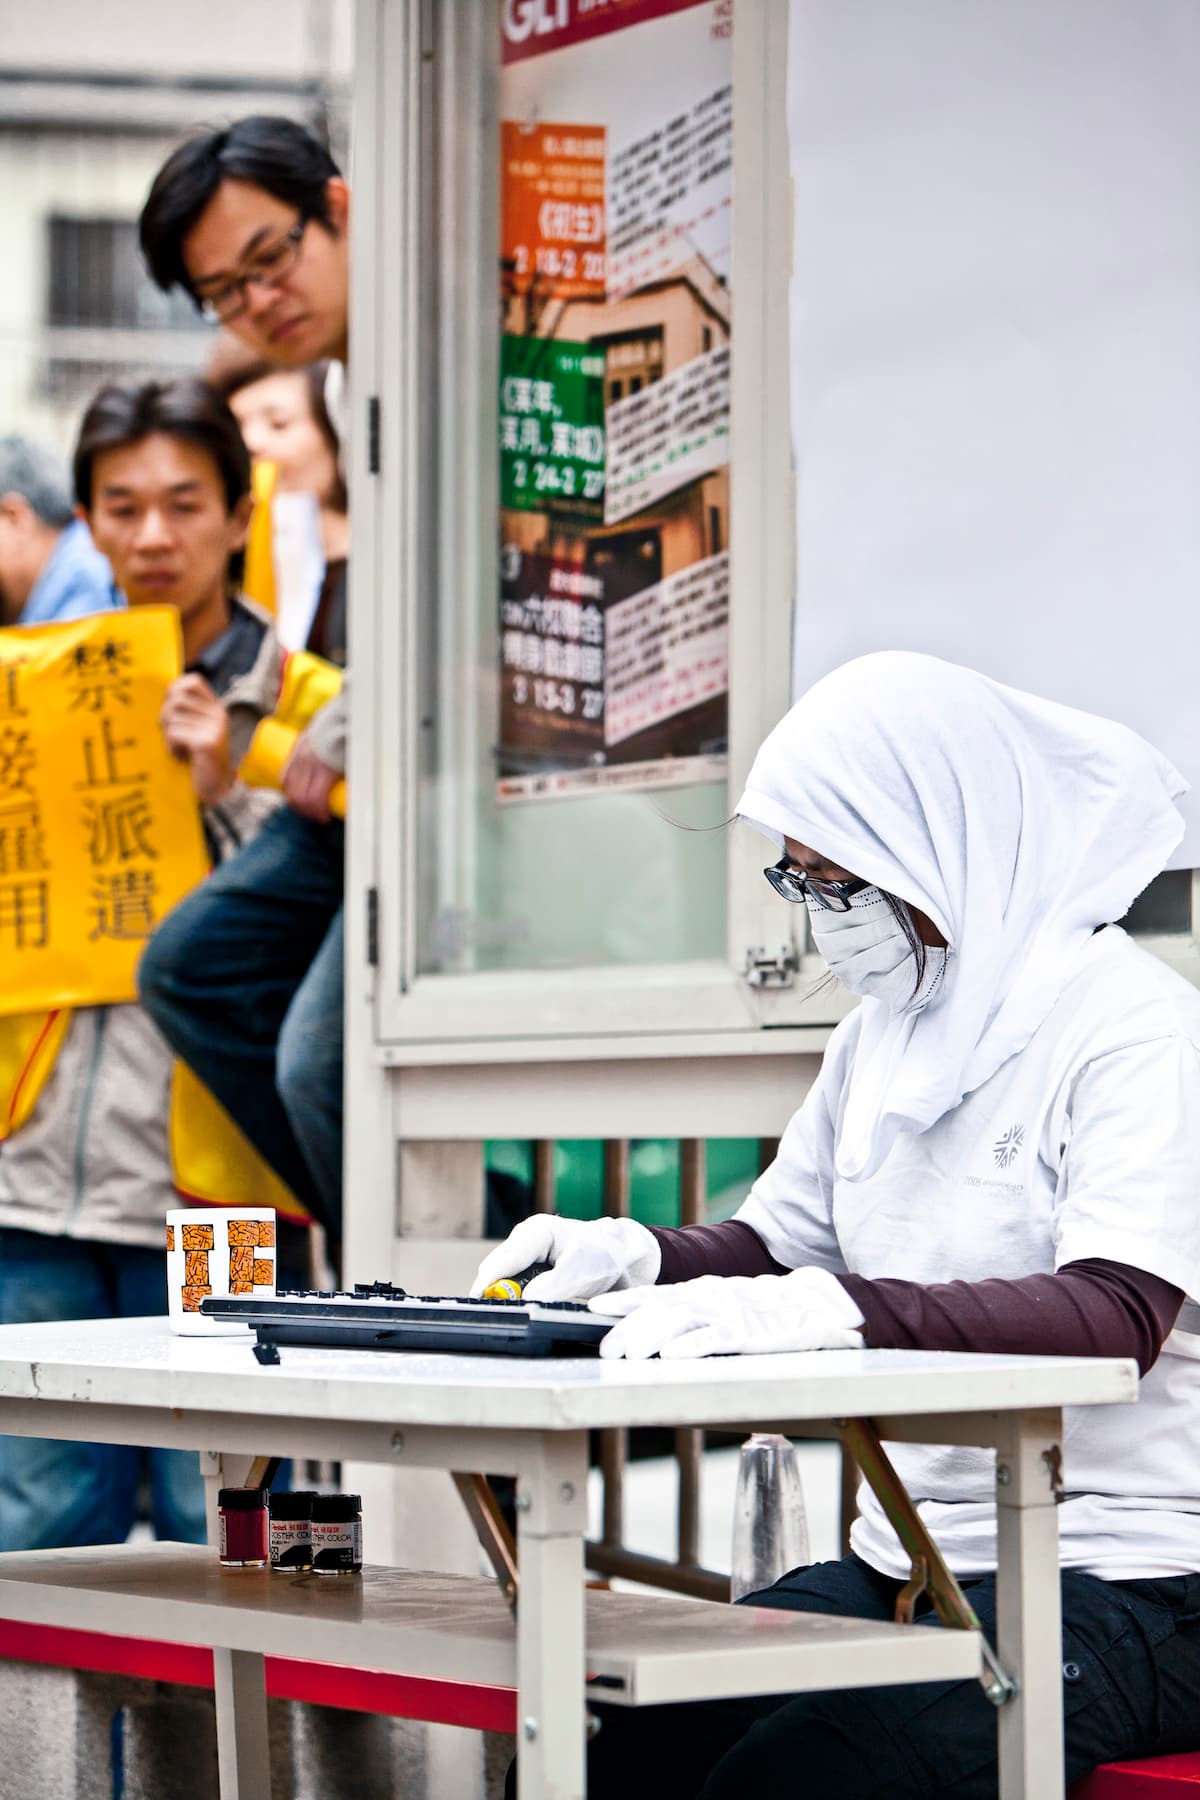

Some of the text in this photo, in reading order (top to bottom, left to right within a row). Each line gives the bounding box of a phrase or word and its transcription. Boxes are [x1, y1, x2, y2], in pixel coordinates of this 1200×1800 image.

[64, 638, 160, 942] 禁止派遣
[327, 1534, 352, 1542] COLOR
